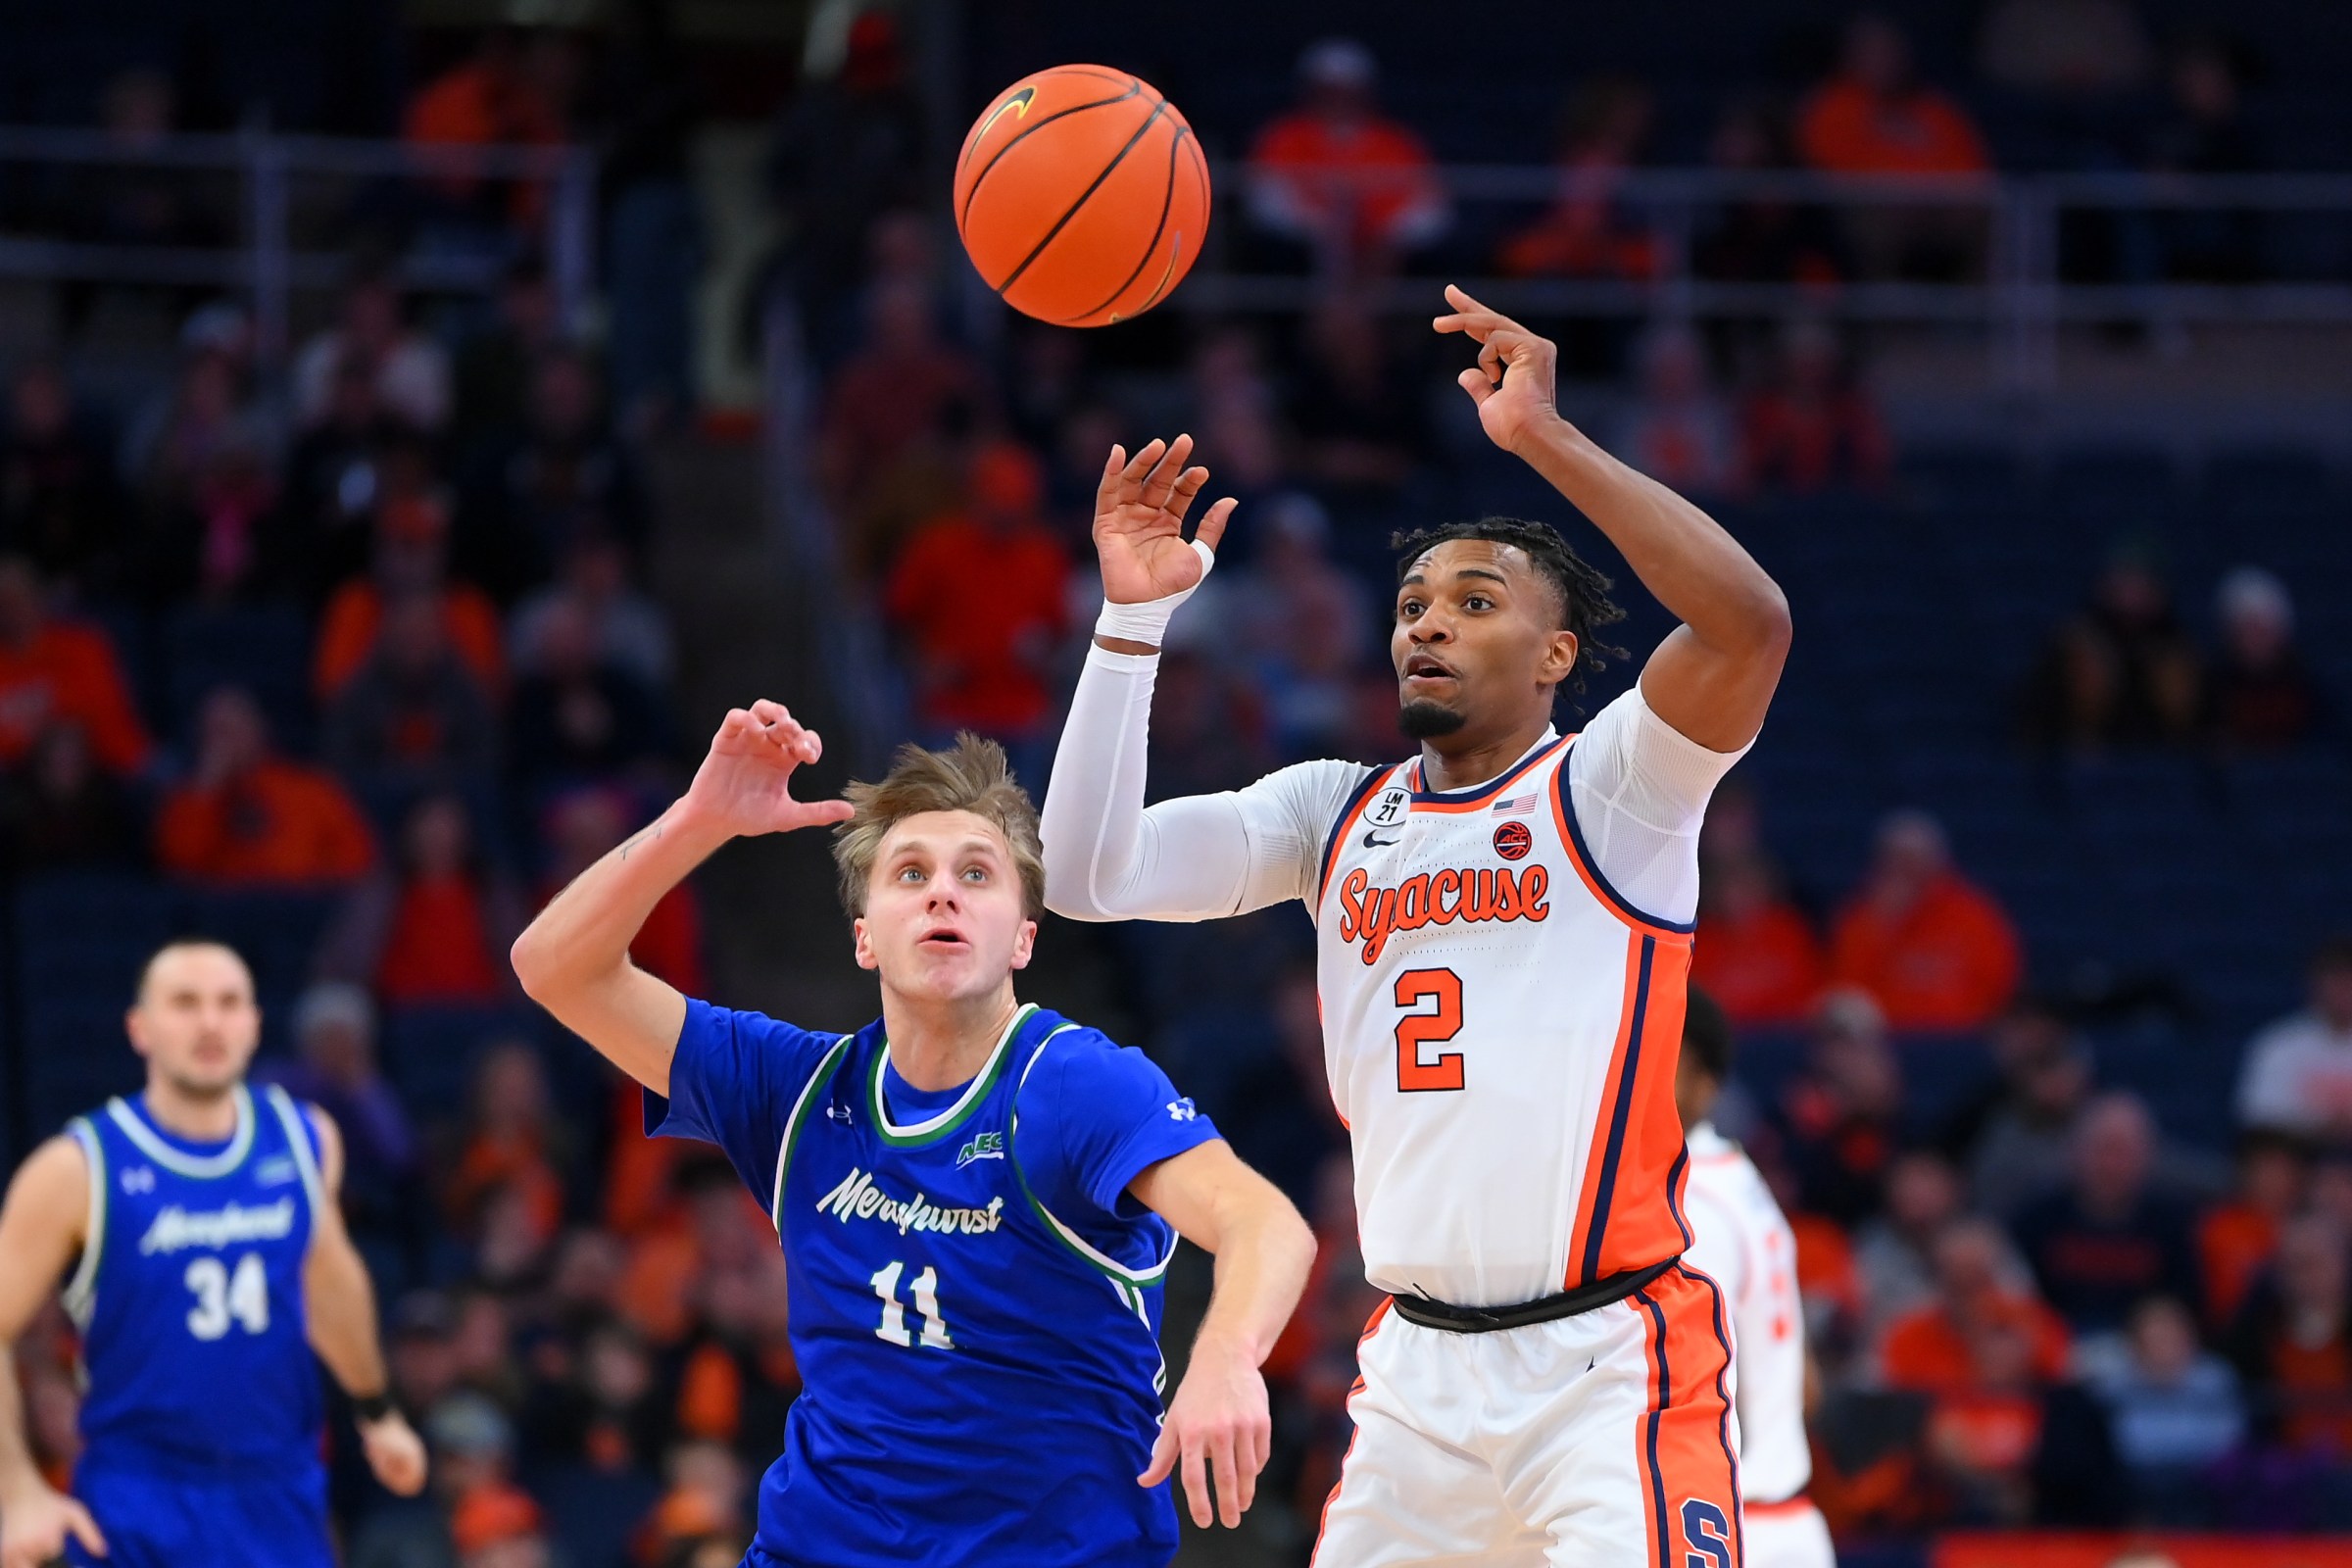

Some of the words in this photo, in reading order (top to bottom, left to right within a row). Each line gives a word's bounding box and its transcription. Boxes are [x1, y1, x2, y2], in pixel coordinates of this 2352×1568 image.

[1375, 804, 1397, 822] 21
[1385, 791, 1404, 805] LM
[1340, 863, 1550, 965] Syacuse
[1393, 966, 1465, 1093] 2
[956, 1131, 1004, 1165] NEC
[184, 1251, 270, 1342] 34
[868, 1259, 956, 1350] 11
